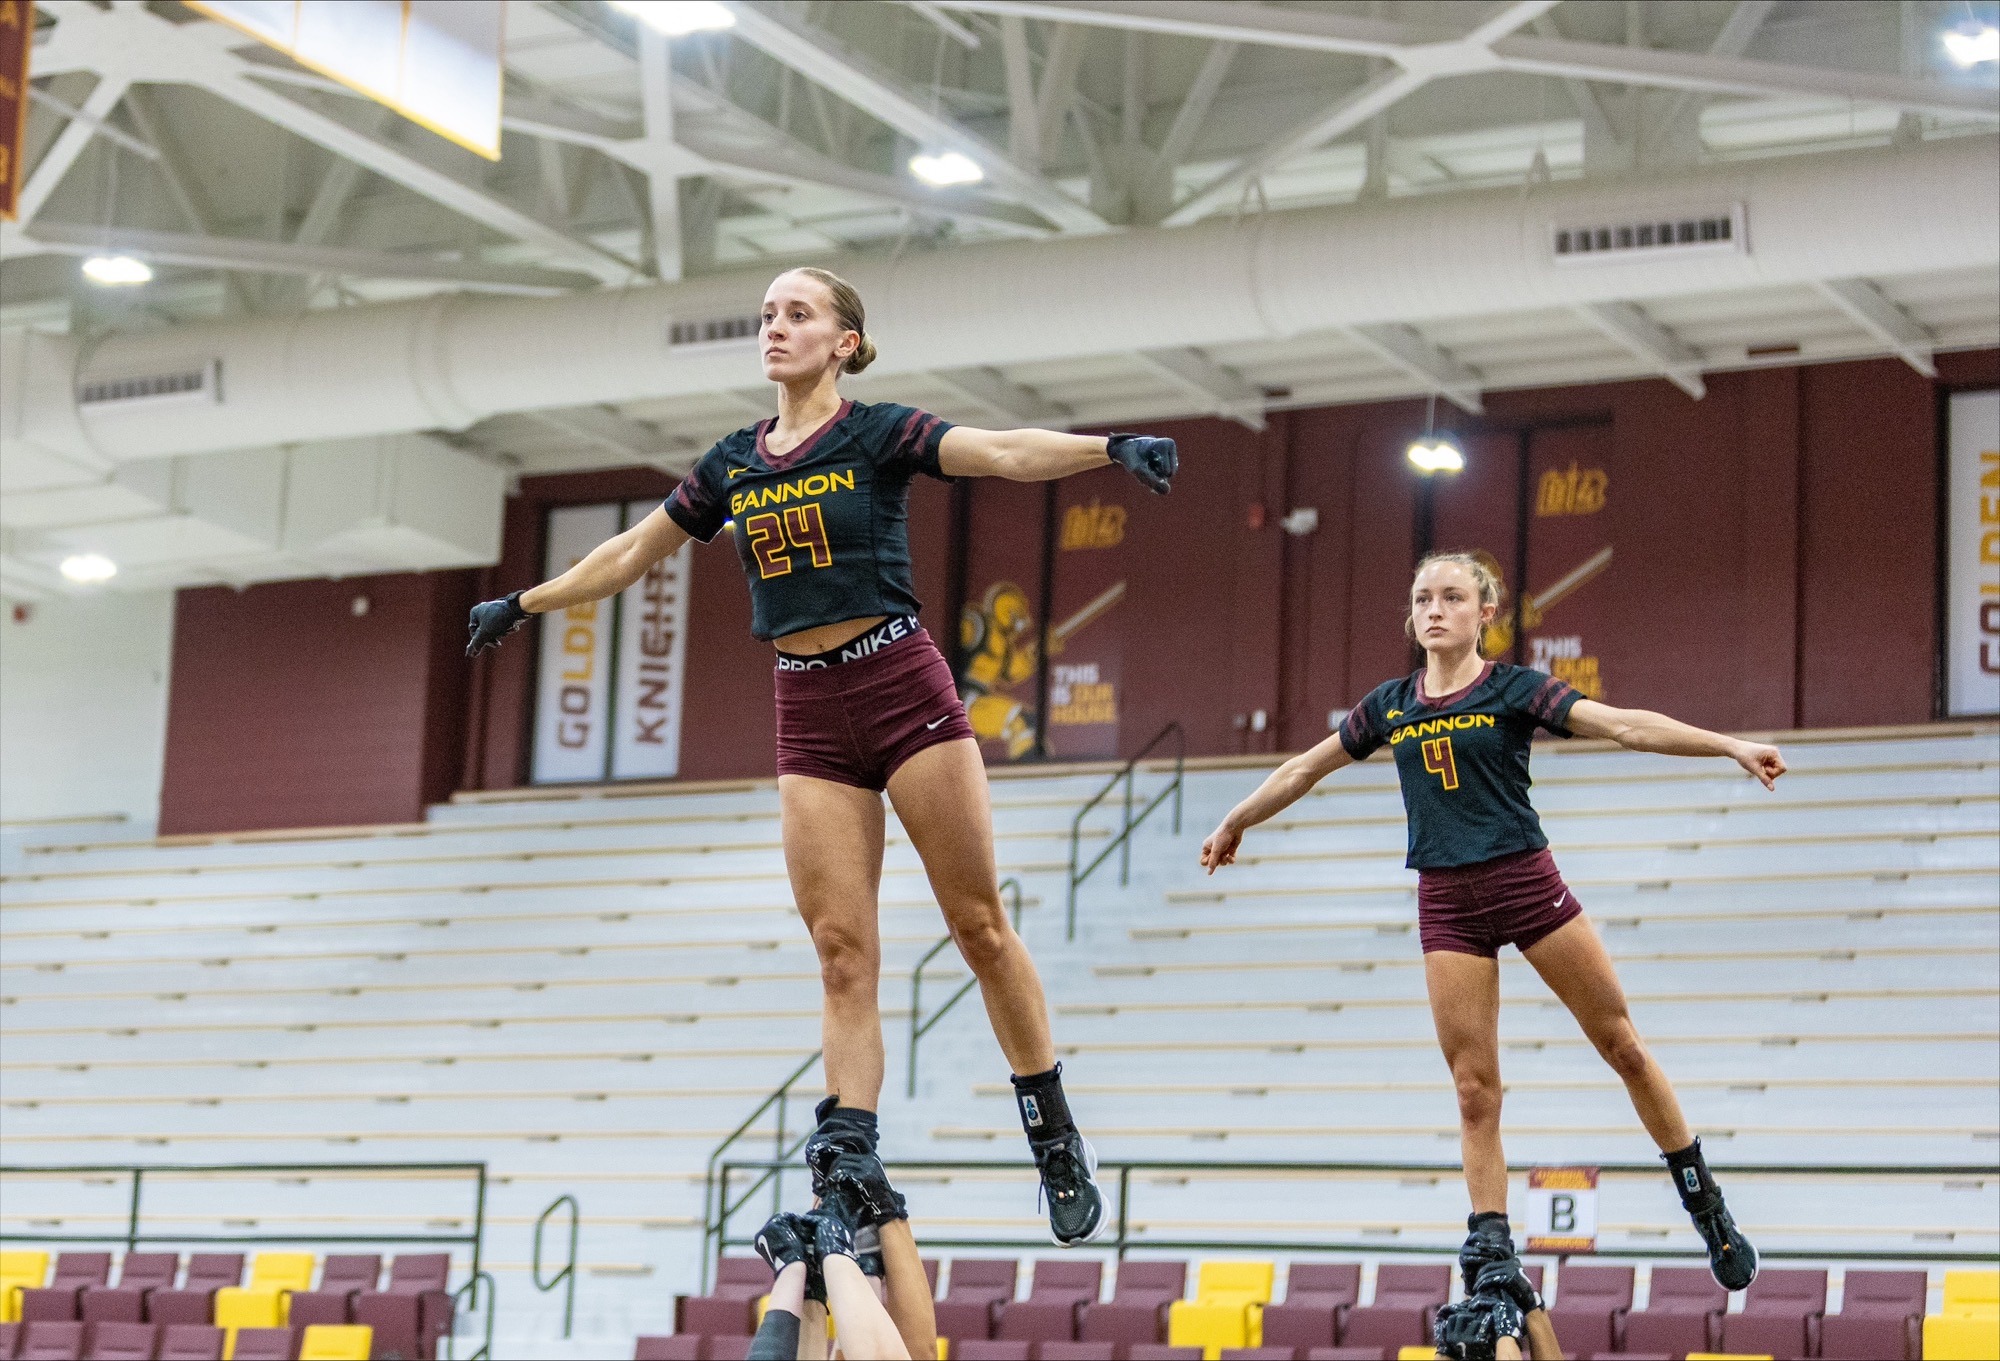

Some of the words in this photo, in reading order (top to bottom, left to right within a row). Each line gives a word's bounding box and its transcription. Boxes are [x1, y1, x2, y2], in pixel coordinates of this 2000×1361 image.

[731, 469, 855, 515] GANNON
[746, 502, 833, 580] 24
[634, 548, 678, 745] KNIGHT
[841, 617, 907, 664] NIKE
[1389, 714, 1496, 745] GANNON
[1420, 736, 1460, 791] 4
[1550, 1194, 1576, 1232] B
